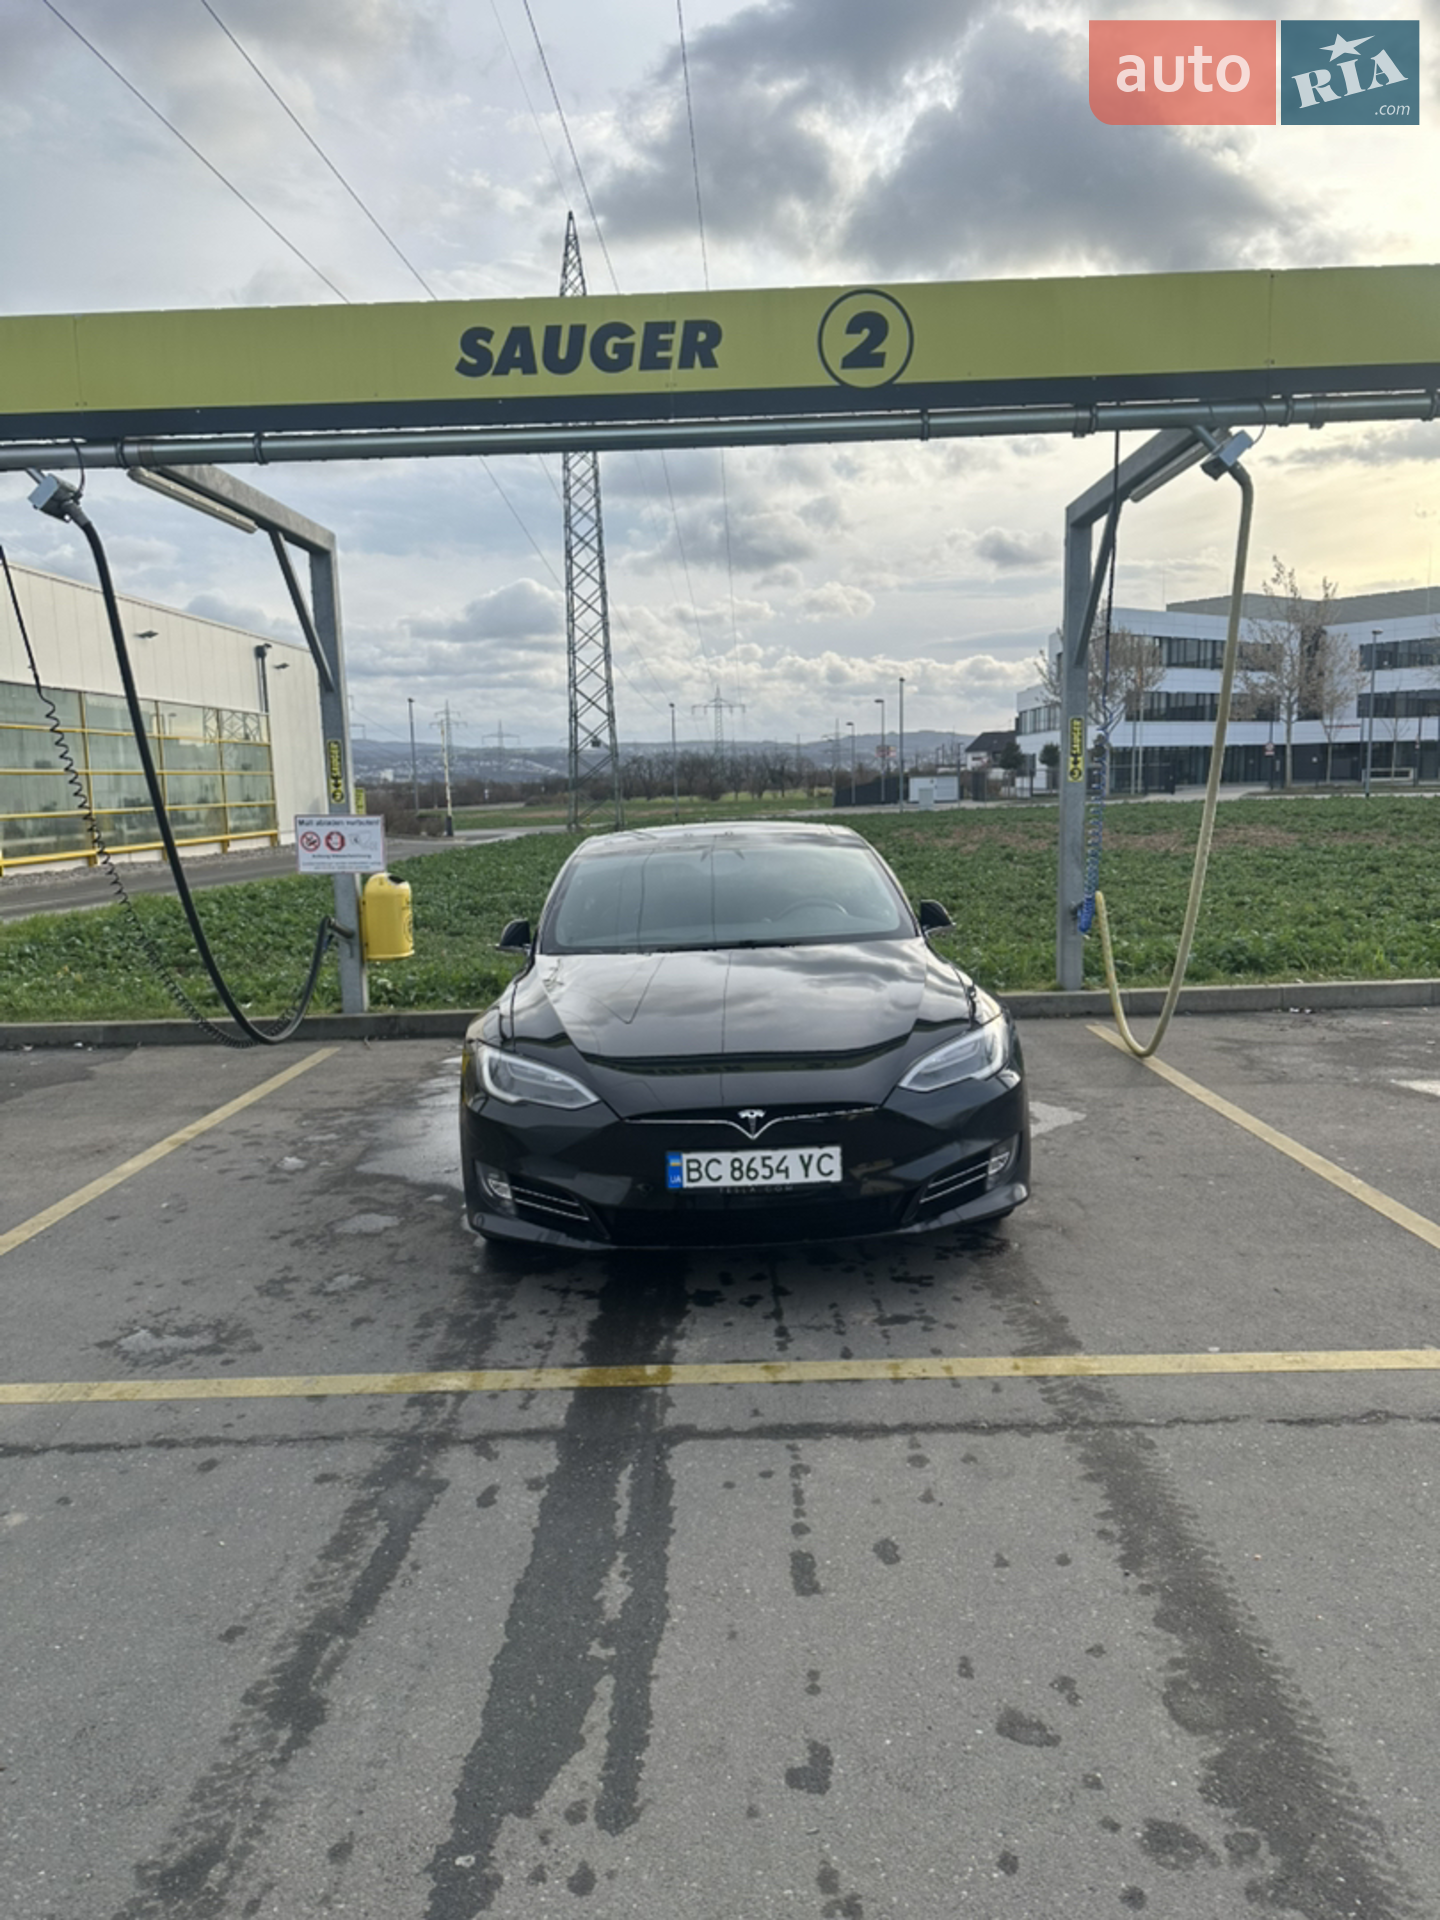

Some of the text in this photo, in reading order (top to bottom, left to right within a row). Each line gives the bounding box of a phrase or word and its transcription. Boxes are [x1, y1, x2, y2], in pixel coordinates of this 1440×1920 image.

[455, 310, 890, 378] SAUGER 2
[670, 1176, 681, 1184] UA
[686, 1152, 835, 1183] BC 8654 YC
